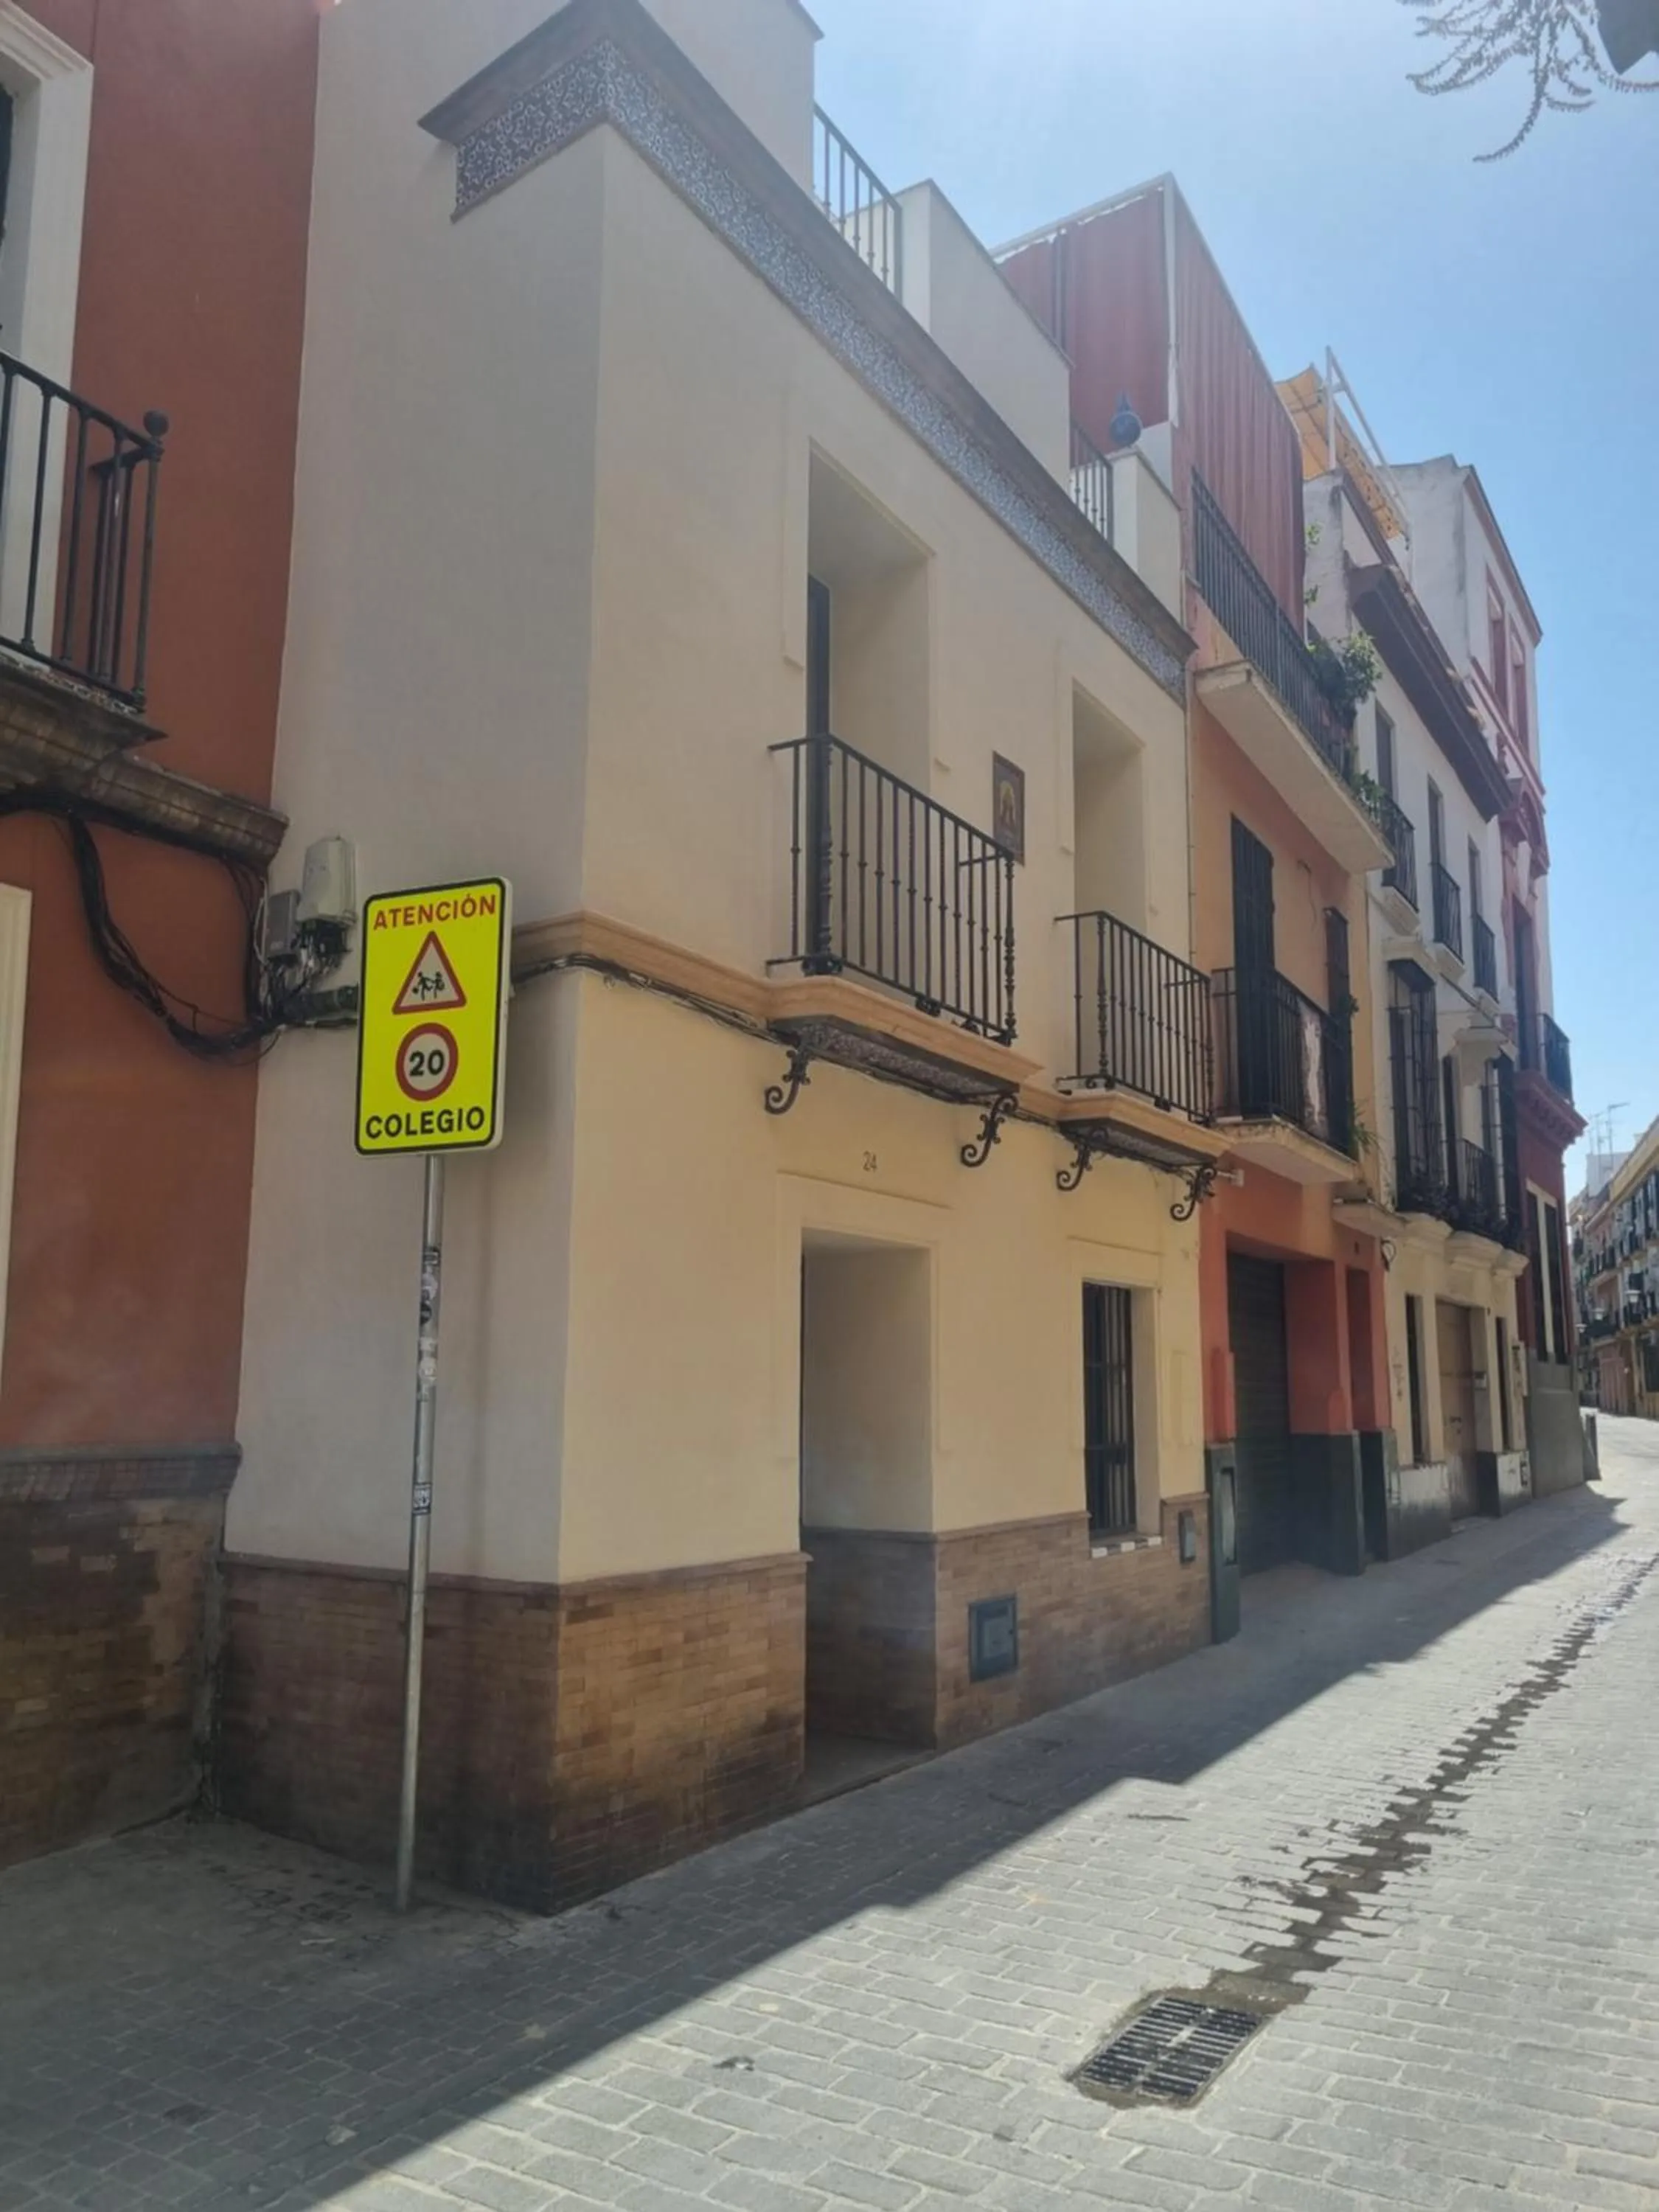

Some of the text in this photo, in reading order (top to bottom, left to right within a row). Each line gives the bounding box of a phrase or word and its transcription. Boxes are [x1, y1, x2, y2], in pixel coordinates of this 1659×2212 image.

[373, 894, 495, 931] ATENCIÓN
[408, 1049, 445, 1077] 20
[366, 1106, 484, 1139] COLEGIO
